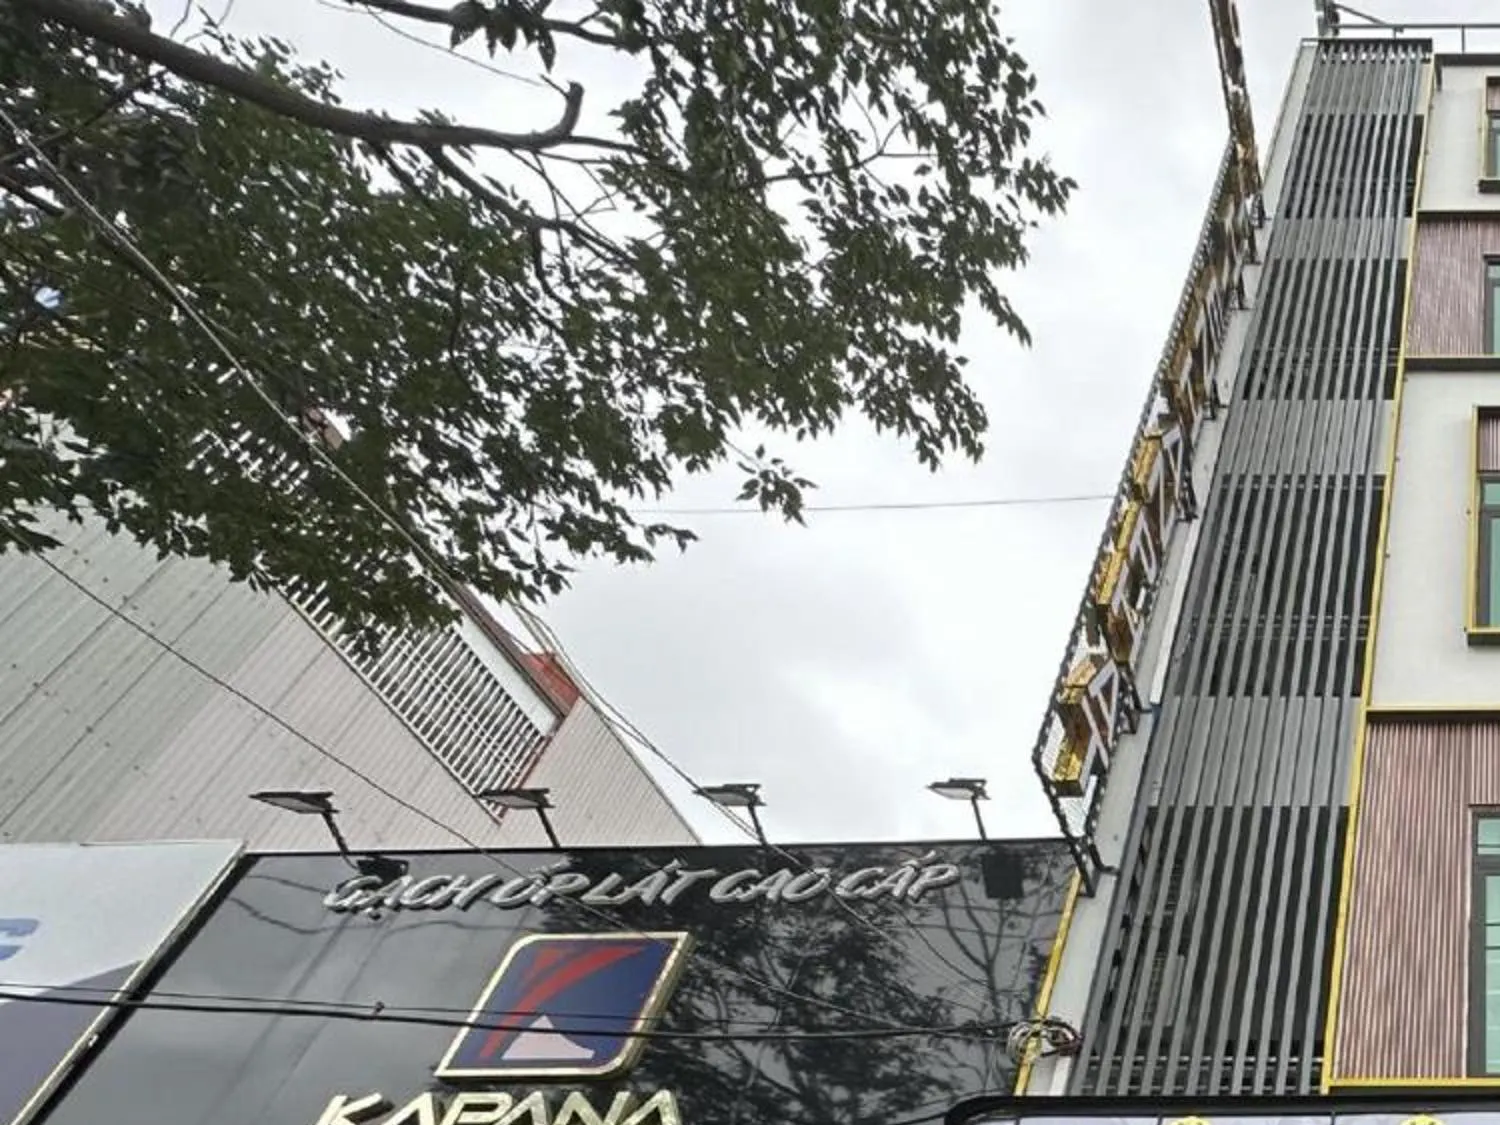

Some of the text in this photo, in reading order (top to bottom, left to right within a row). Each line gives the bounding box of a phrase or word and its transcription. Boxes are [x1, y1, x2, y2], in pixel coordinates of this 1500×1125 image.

[583, 858, 716, 904] LÁT
[709, 867, 832, 902] CAO
[836, 851, 961, 902] CẤP
